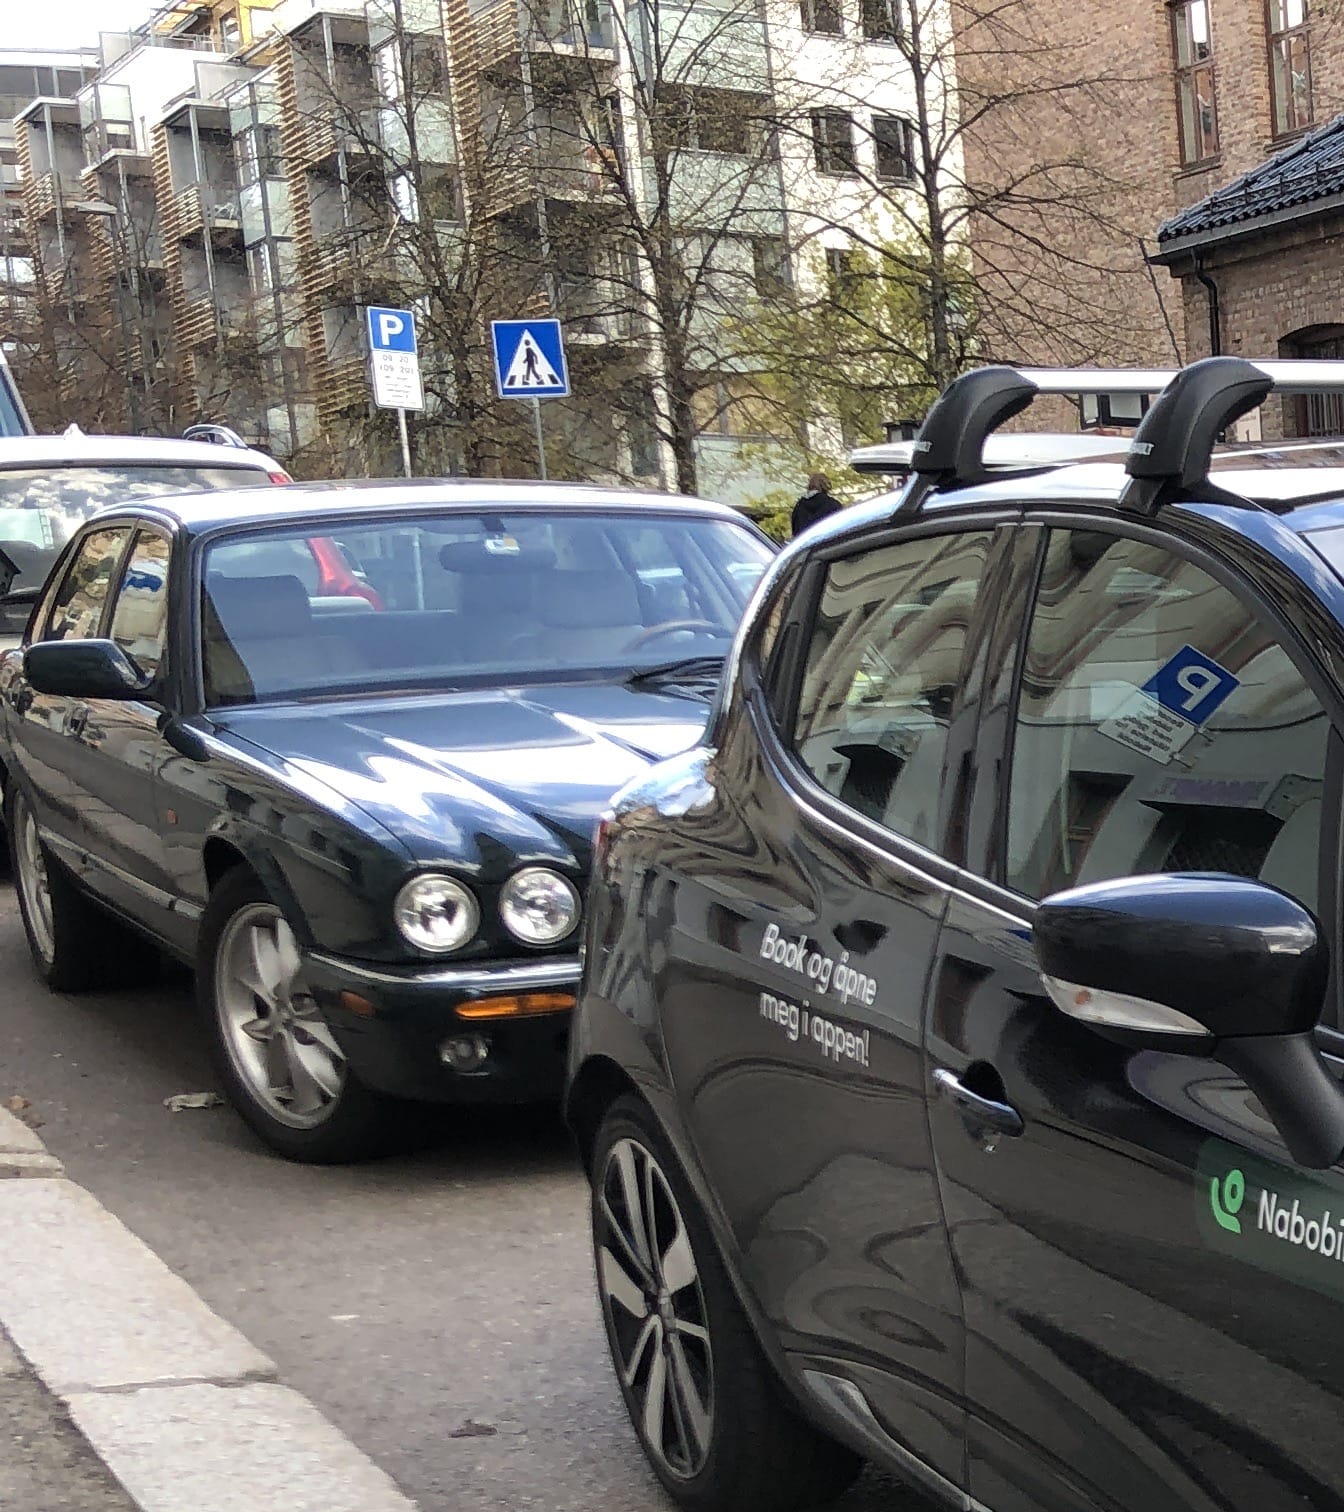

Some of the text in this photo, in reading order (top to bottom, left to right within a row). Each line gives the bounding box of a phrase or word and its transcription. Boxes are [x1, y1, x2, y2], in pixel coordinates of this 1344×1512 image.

[379, 313, 404, 346] P
[760, 923, 877, 1005] Book og åpne
[760, 992, 870, 1067] meg i appen!
